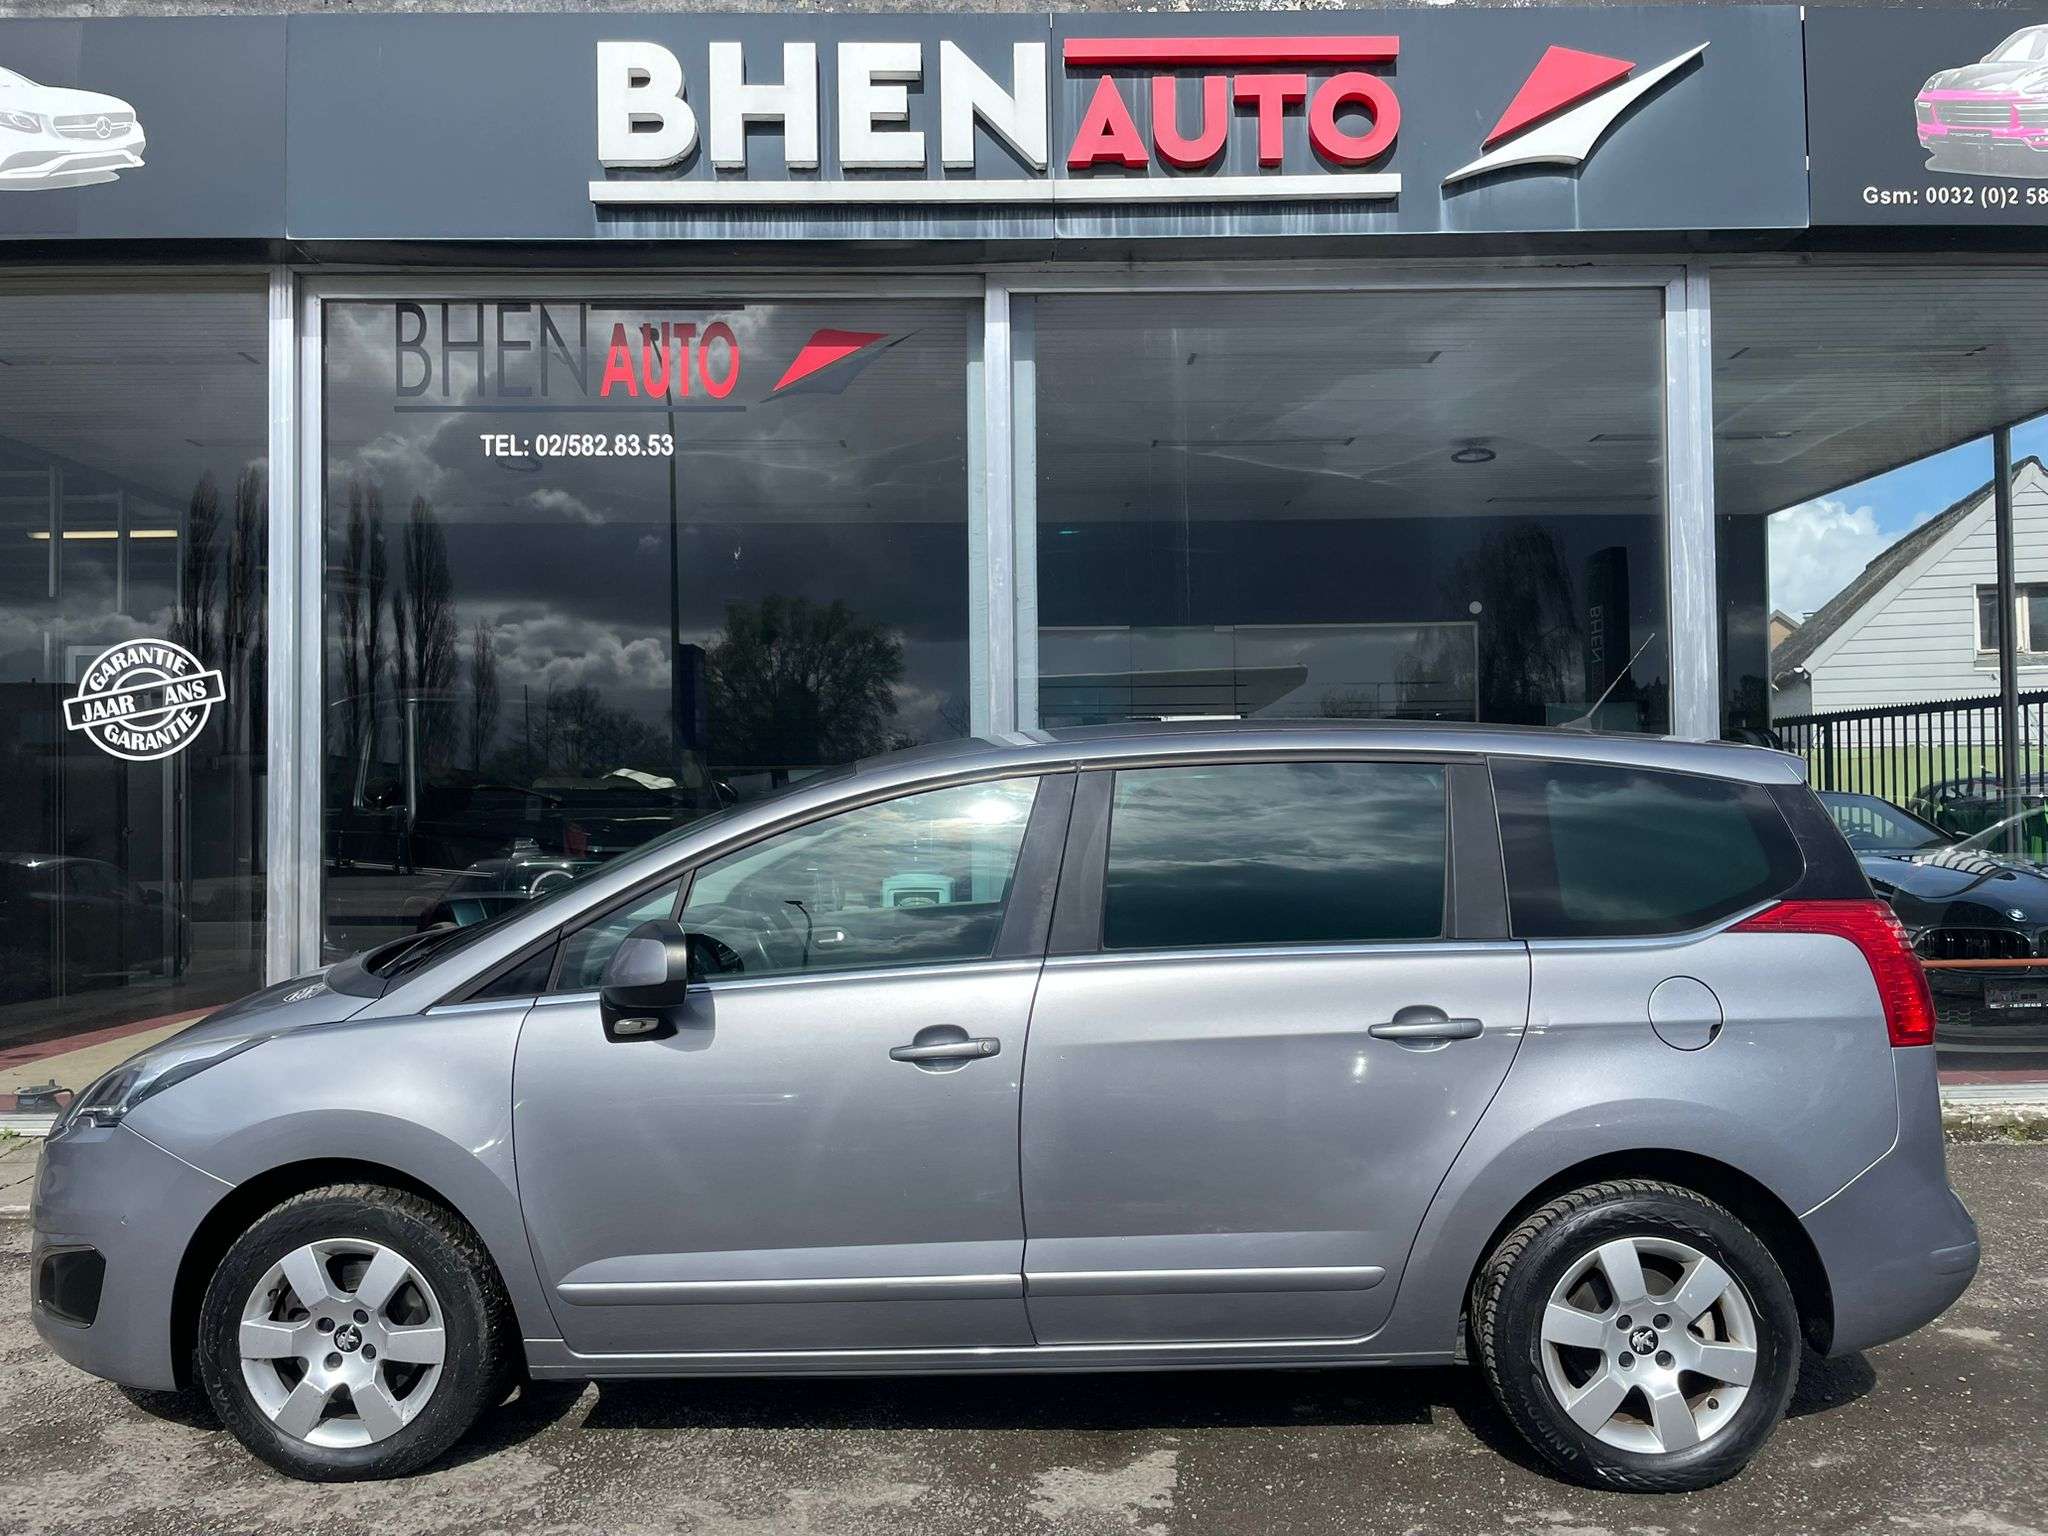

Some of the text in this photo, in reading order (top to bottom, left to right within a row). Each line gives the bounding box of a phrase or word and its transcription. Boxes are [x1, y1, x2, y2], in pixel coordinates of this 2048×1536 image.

[596, 41, 1401, 170] BHEN AUTO
[1863, 186, 1918, 204] Gsm:
[1925, 187, 1974, 204] 0032
[1981, 186, 2019, 208] (0)2
[395, 302, 741, 399] BHEN AUTO
[480, 433, 674, 458] TEL: 02/582.83.53
[89, 646, 189, 692] GARANTIE
[82, 679, 207, 722] JAAR ANS
[104, 707, 198, 751] GARANTIE
